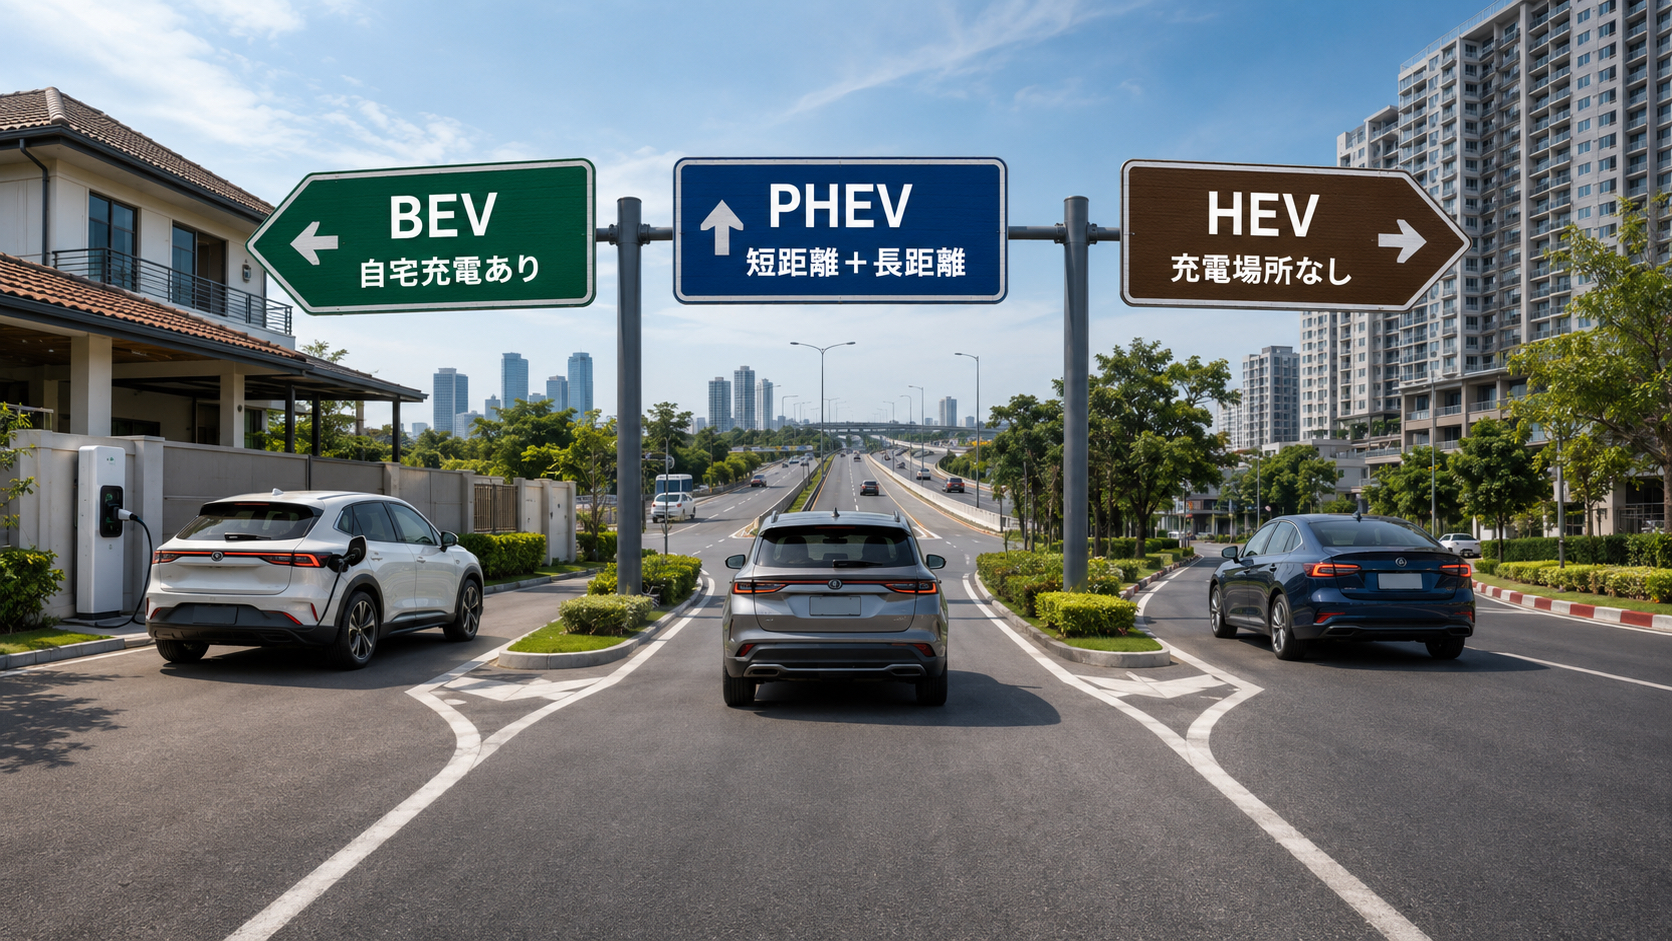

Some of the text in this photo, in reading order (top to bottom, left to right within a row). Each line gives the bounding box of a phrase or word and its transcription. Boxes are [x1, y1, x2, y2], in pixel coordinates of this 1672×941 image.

[391, 192, 498, 239] BEV
[770, 184, 913, 228] PHEV
[1209, 191, 1320, 238] HEV
[361, 255, 539, 288] 自宅充電あり
[1171, 253, 1352, 286] 充電場所なし
